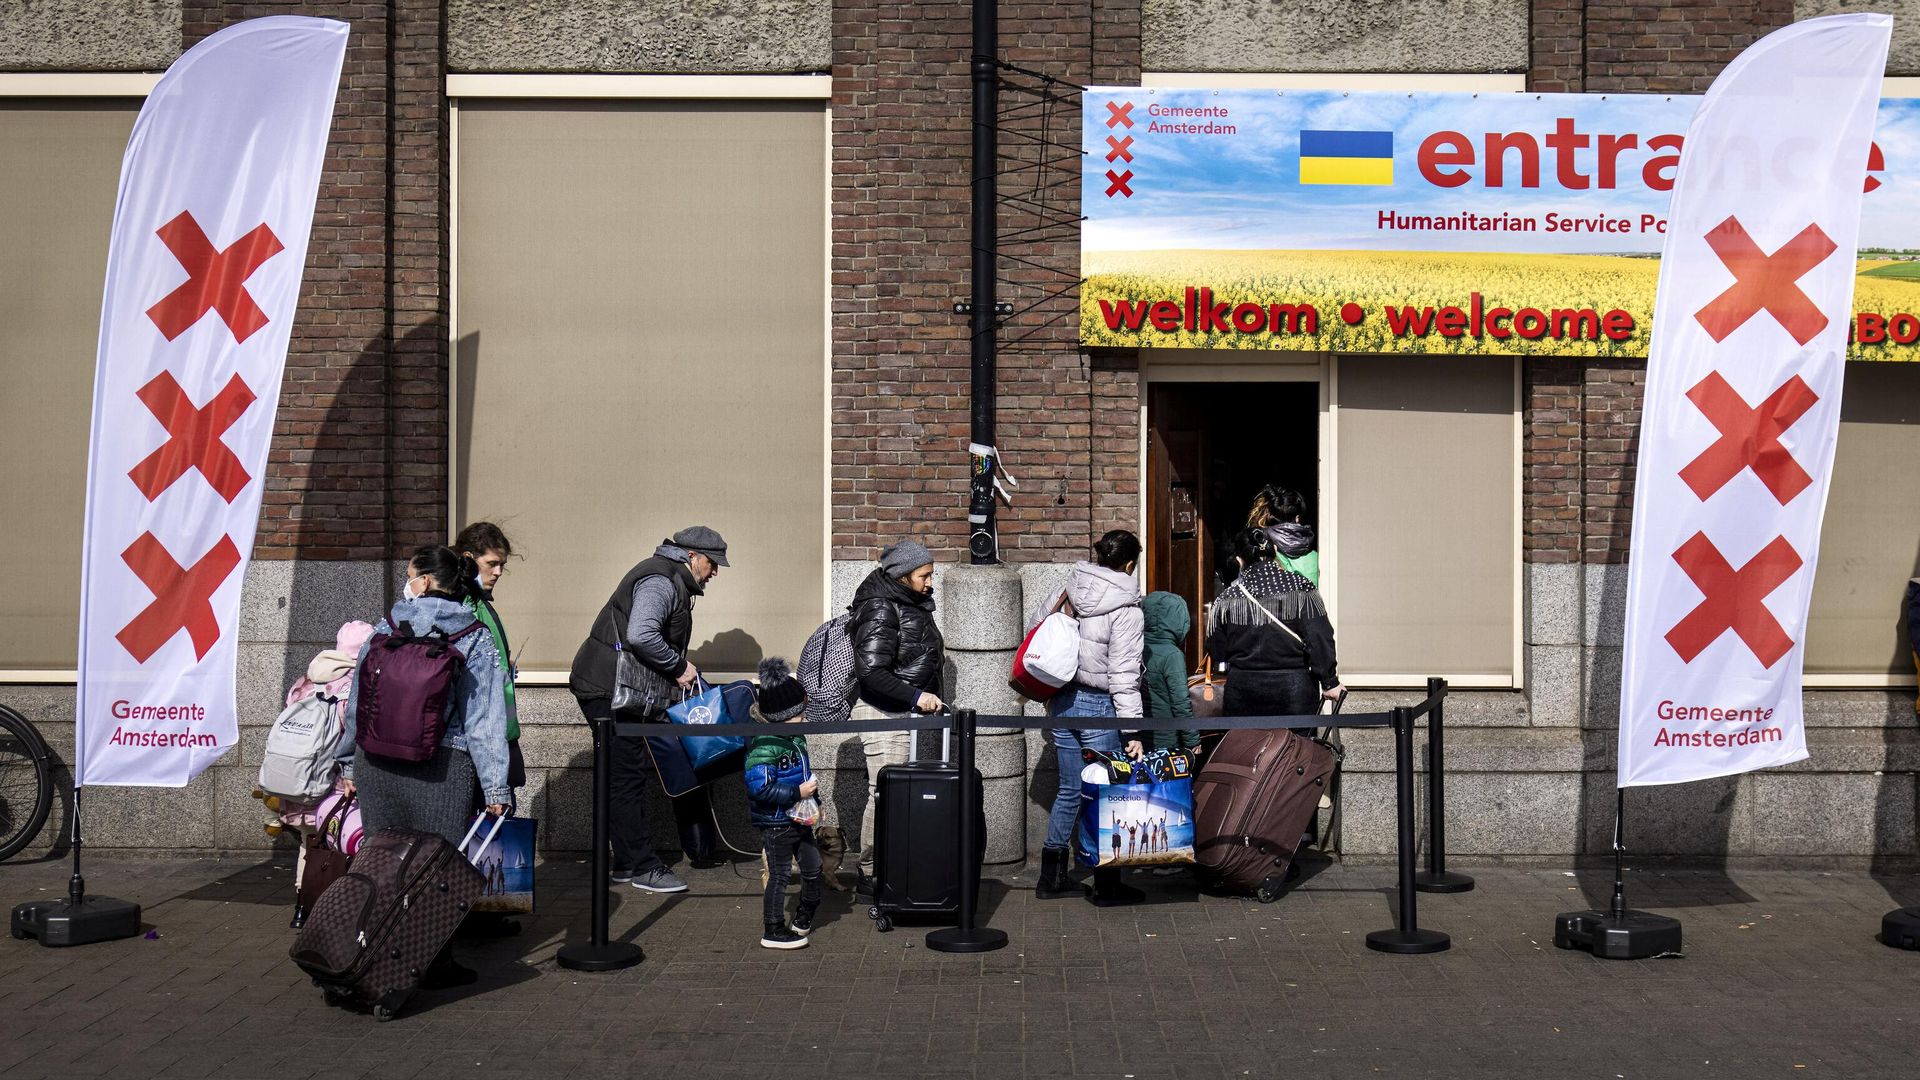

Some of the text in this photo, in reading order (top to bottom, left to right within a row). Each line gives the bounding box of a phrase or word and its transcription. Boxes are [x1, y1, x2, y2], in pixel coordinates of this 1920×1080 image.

[1148, 103, 1228, 118] Gemeente
[1148, 119, 1237, 136] Amsterdam
[1377, 210, 1537, 233] Humanitarian
[1545, 212, 1632, 234] Service
[1098, 285, 1635, 341] welkom welcome
[111, 699, 205, 721] Gemeente
[1657, 699, 1773, 722] Gemeente
[109, 726, 217, 748] Amsterdam
[1653, 727, 1783, 748] Amsterdam
